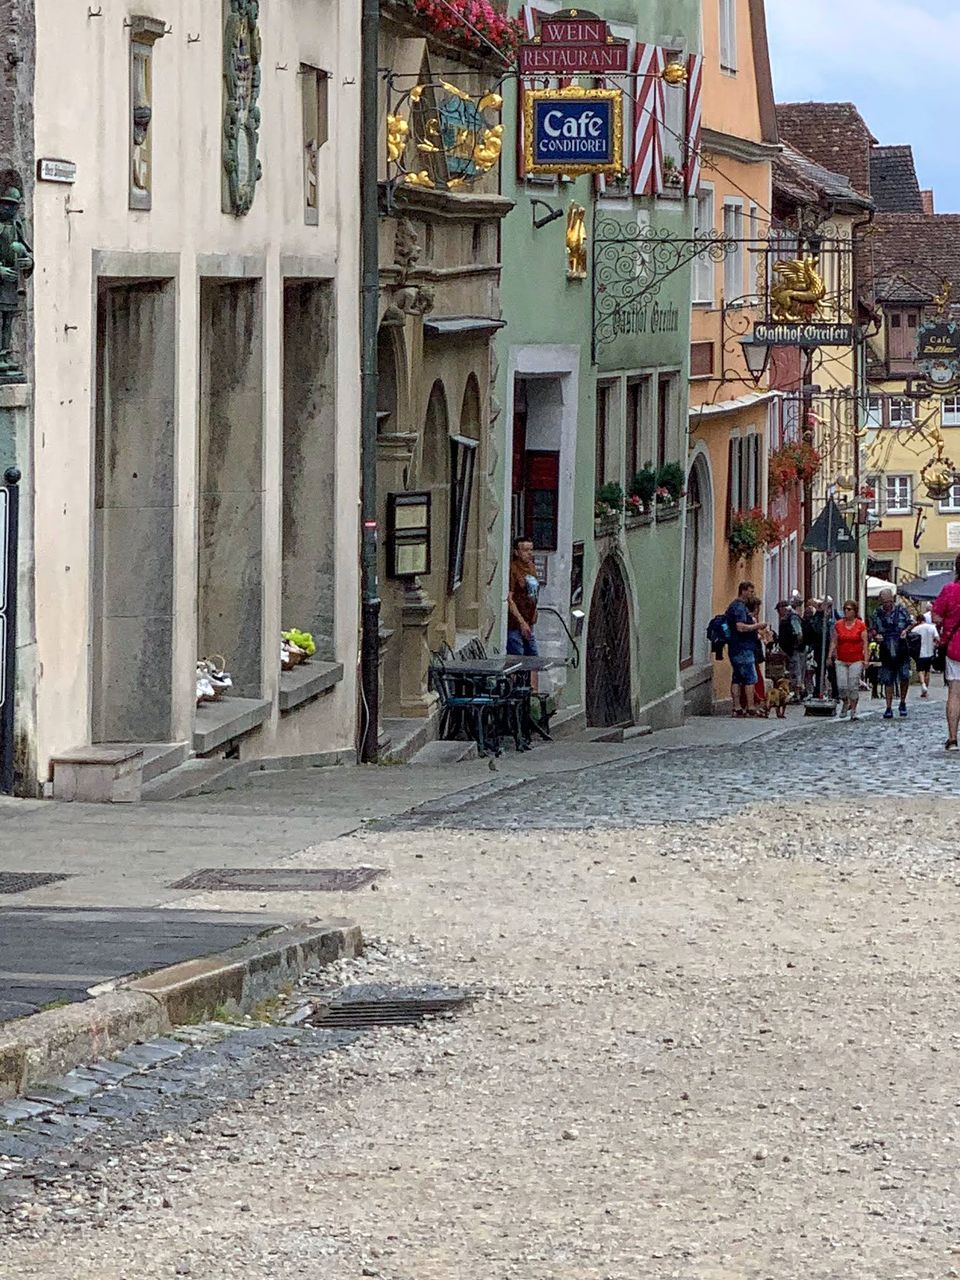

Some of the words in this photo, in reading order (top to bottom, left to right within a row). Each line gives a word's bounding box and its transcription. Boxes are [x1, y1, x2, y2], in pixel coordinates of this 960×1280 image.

[547, 24, 599, 40] WEIN
[524, 49, 624, 66] RESTAURANT
[539, 139, 606, 152] CONDITOREI
